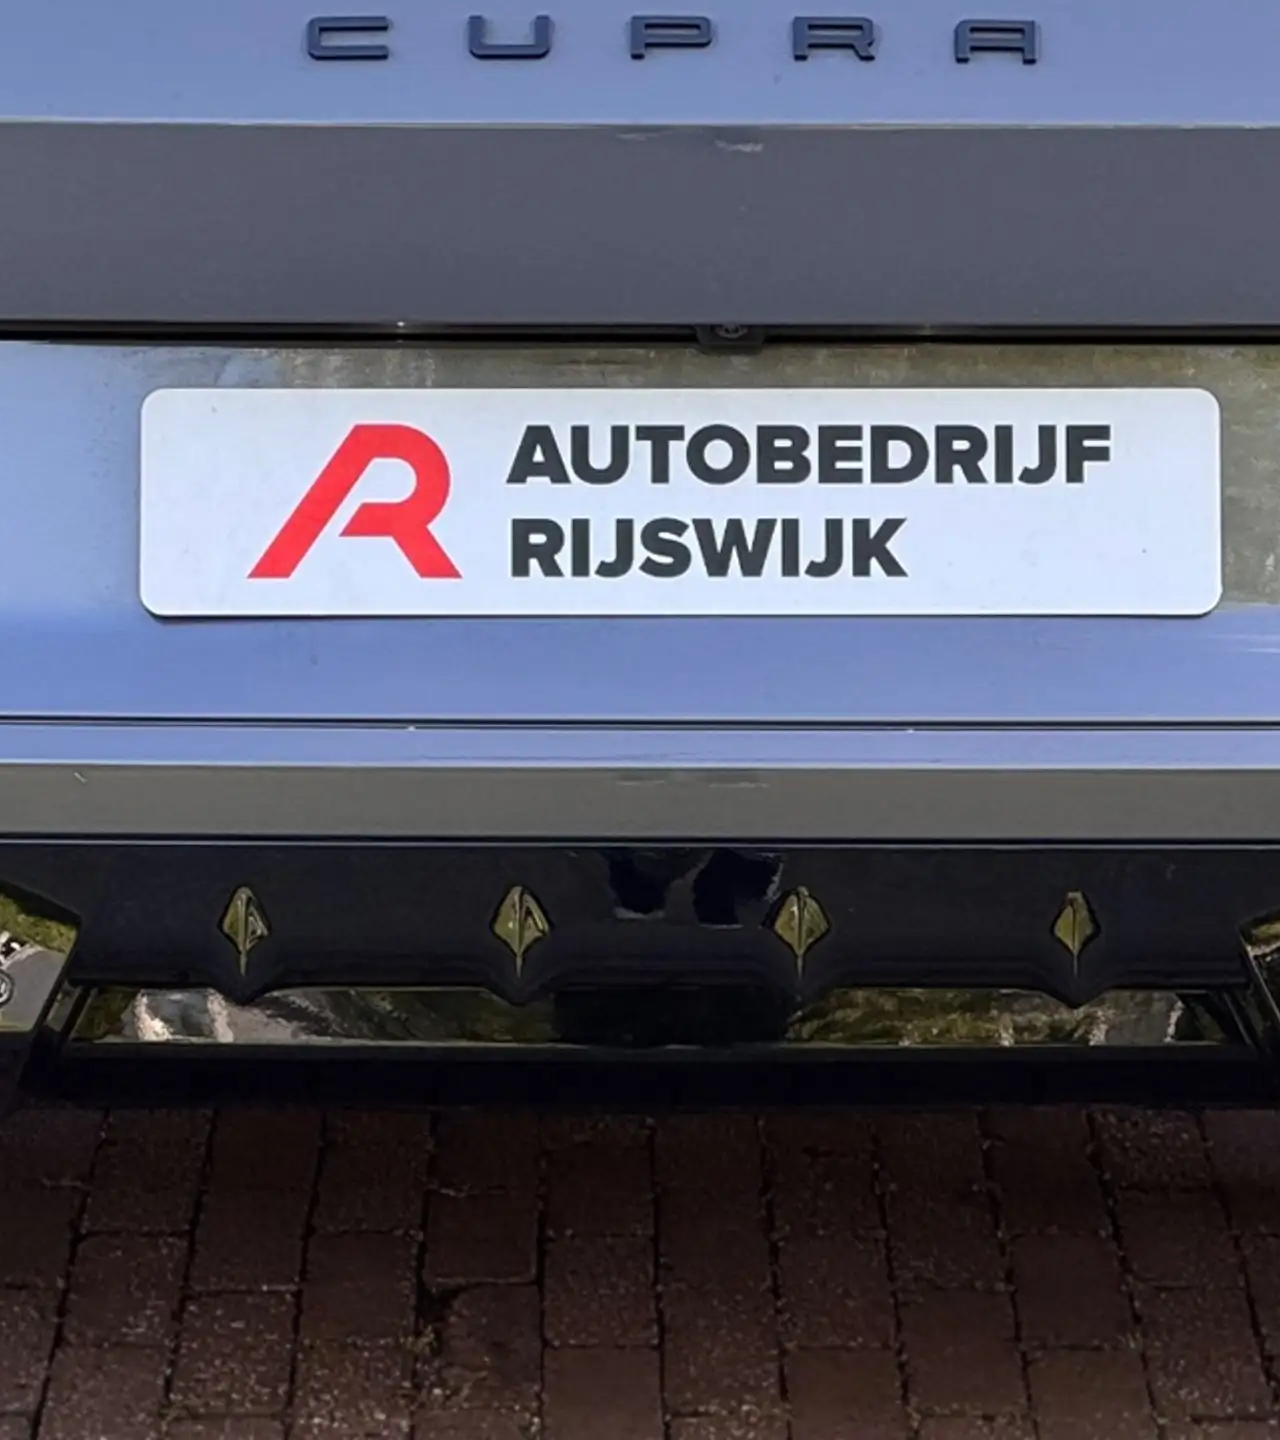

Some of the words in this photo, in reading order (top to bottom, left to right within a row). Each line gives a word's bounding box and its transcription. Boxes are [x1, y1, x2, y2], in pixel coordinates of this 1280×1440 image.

[306, 15, 1039, 64] CUPRA
[505, 422, 1112, 485] AUTOBEDRIJF
[510, 516, 909, 578] RIJSWIJK
